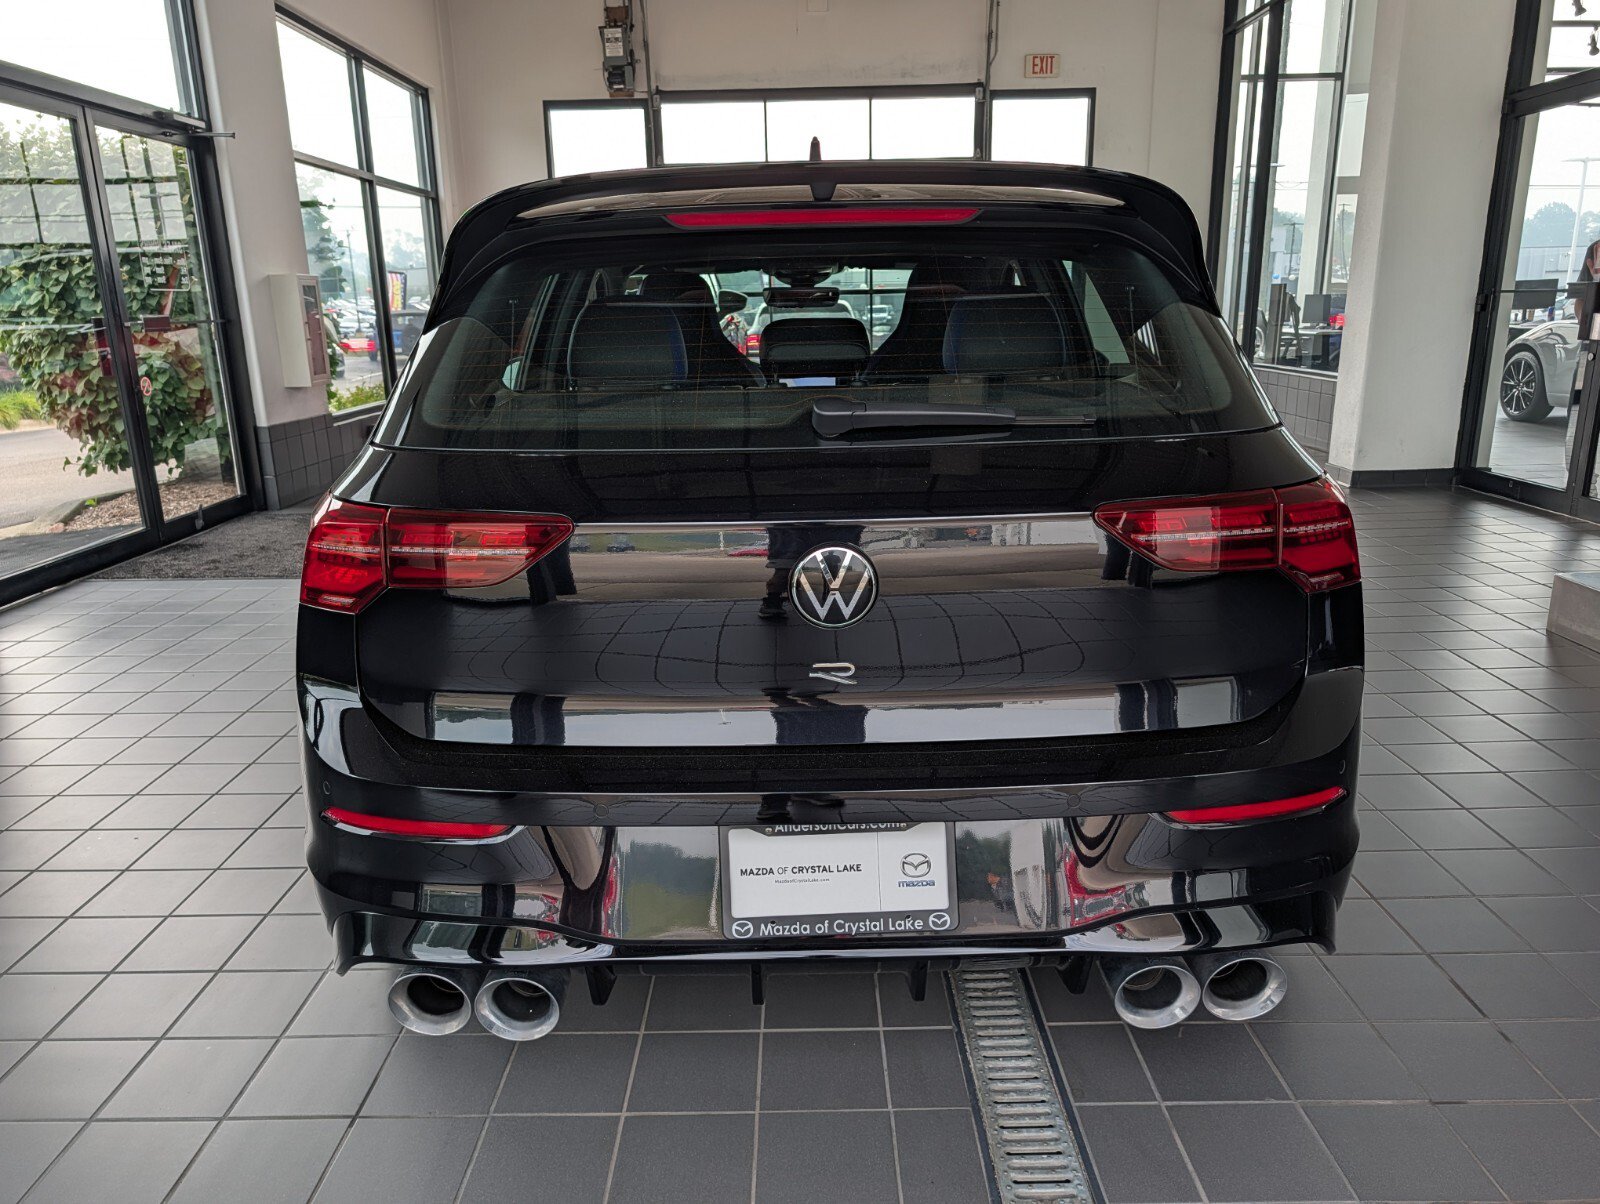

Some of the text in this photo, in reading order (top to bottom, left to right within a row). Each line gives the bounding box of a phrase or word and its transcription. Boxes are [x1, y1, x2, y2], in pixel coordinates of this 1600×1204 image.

[1032, 55, 1055, 75] EXIT
[740, 863, 862, 877] MAZDA OF CRYSTAL LAKE
[760, 917, 924, 936] Mazda of Crystal Lake
